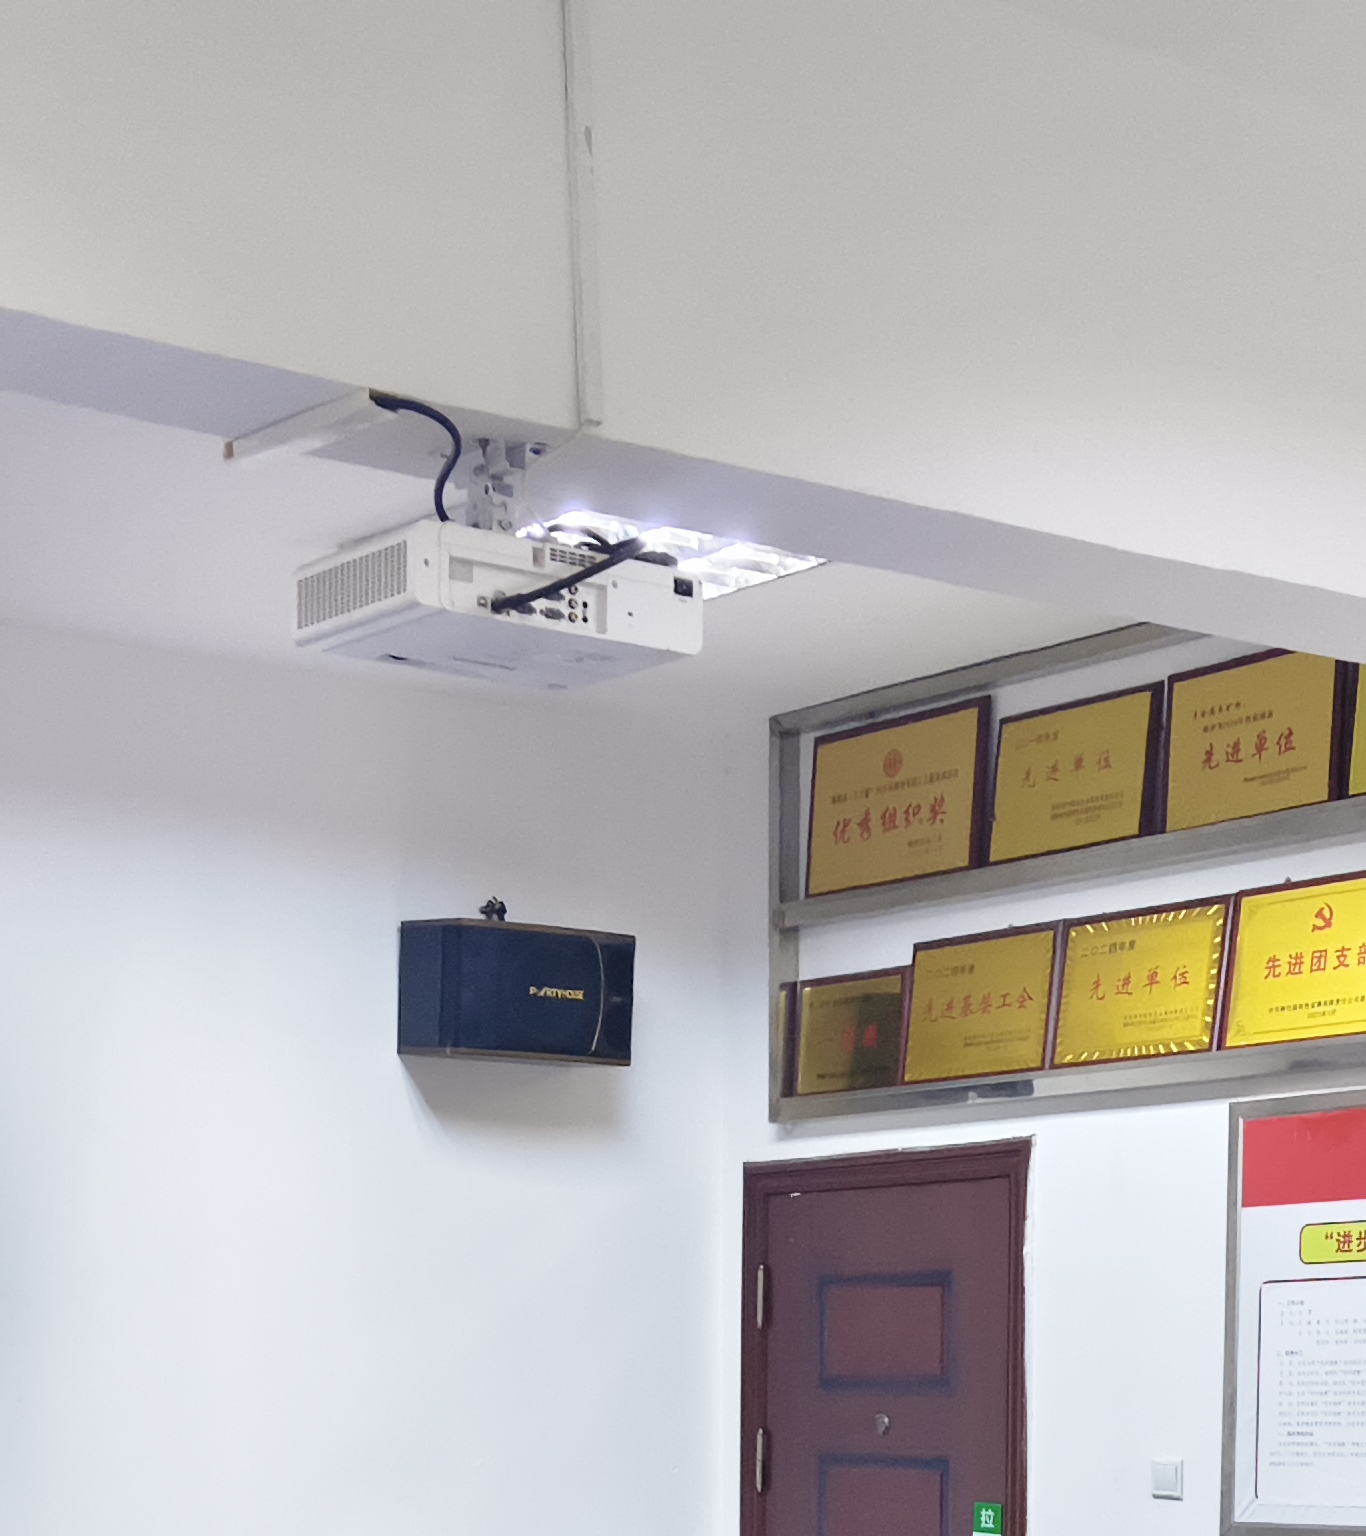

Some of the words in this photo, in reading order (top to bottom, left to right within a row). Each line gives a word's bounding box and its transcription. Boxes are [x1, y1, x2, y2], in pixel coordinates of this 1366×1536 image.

[1202, 727, 1296, 770] 先进单位
[1089, 965, 1190, 1001] 先进单位
[980, 1507, 995, 1528] 拉
